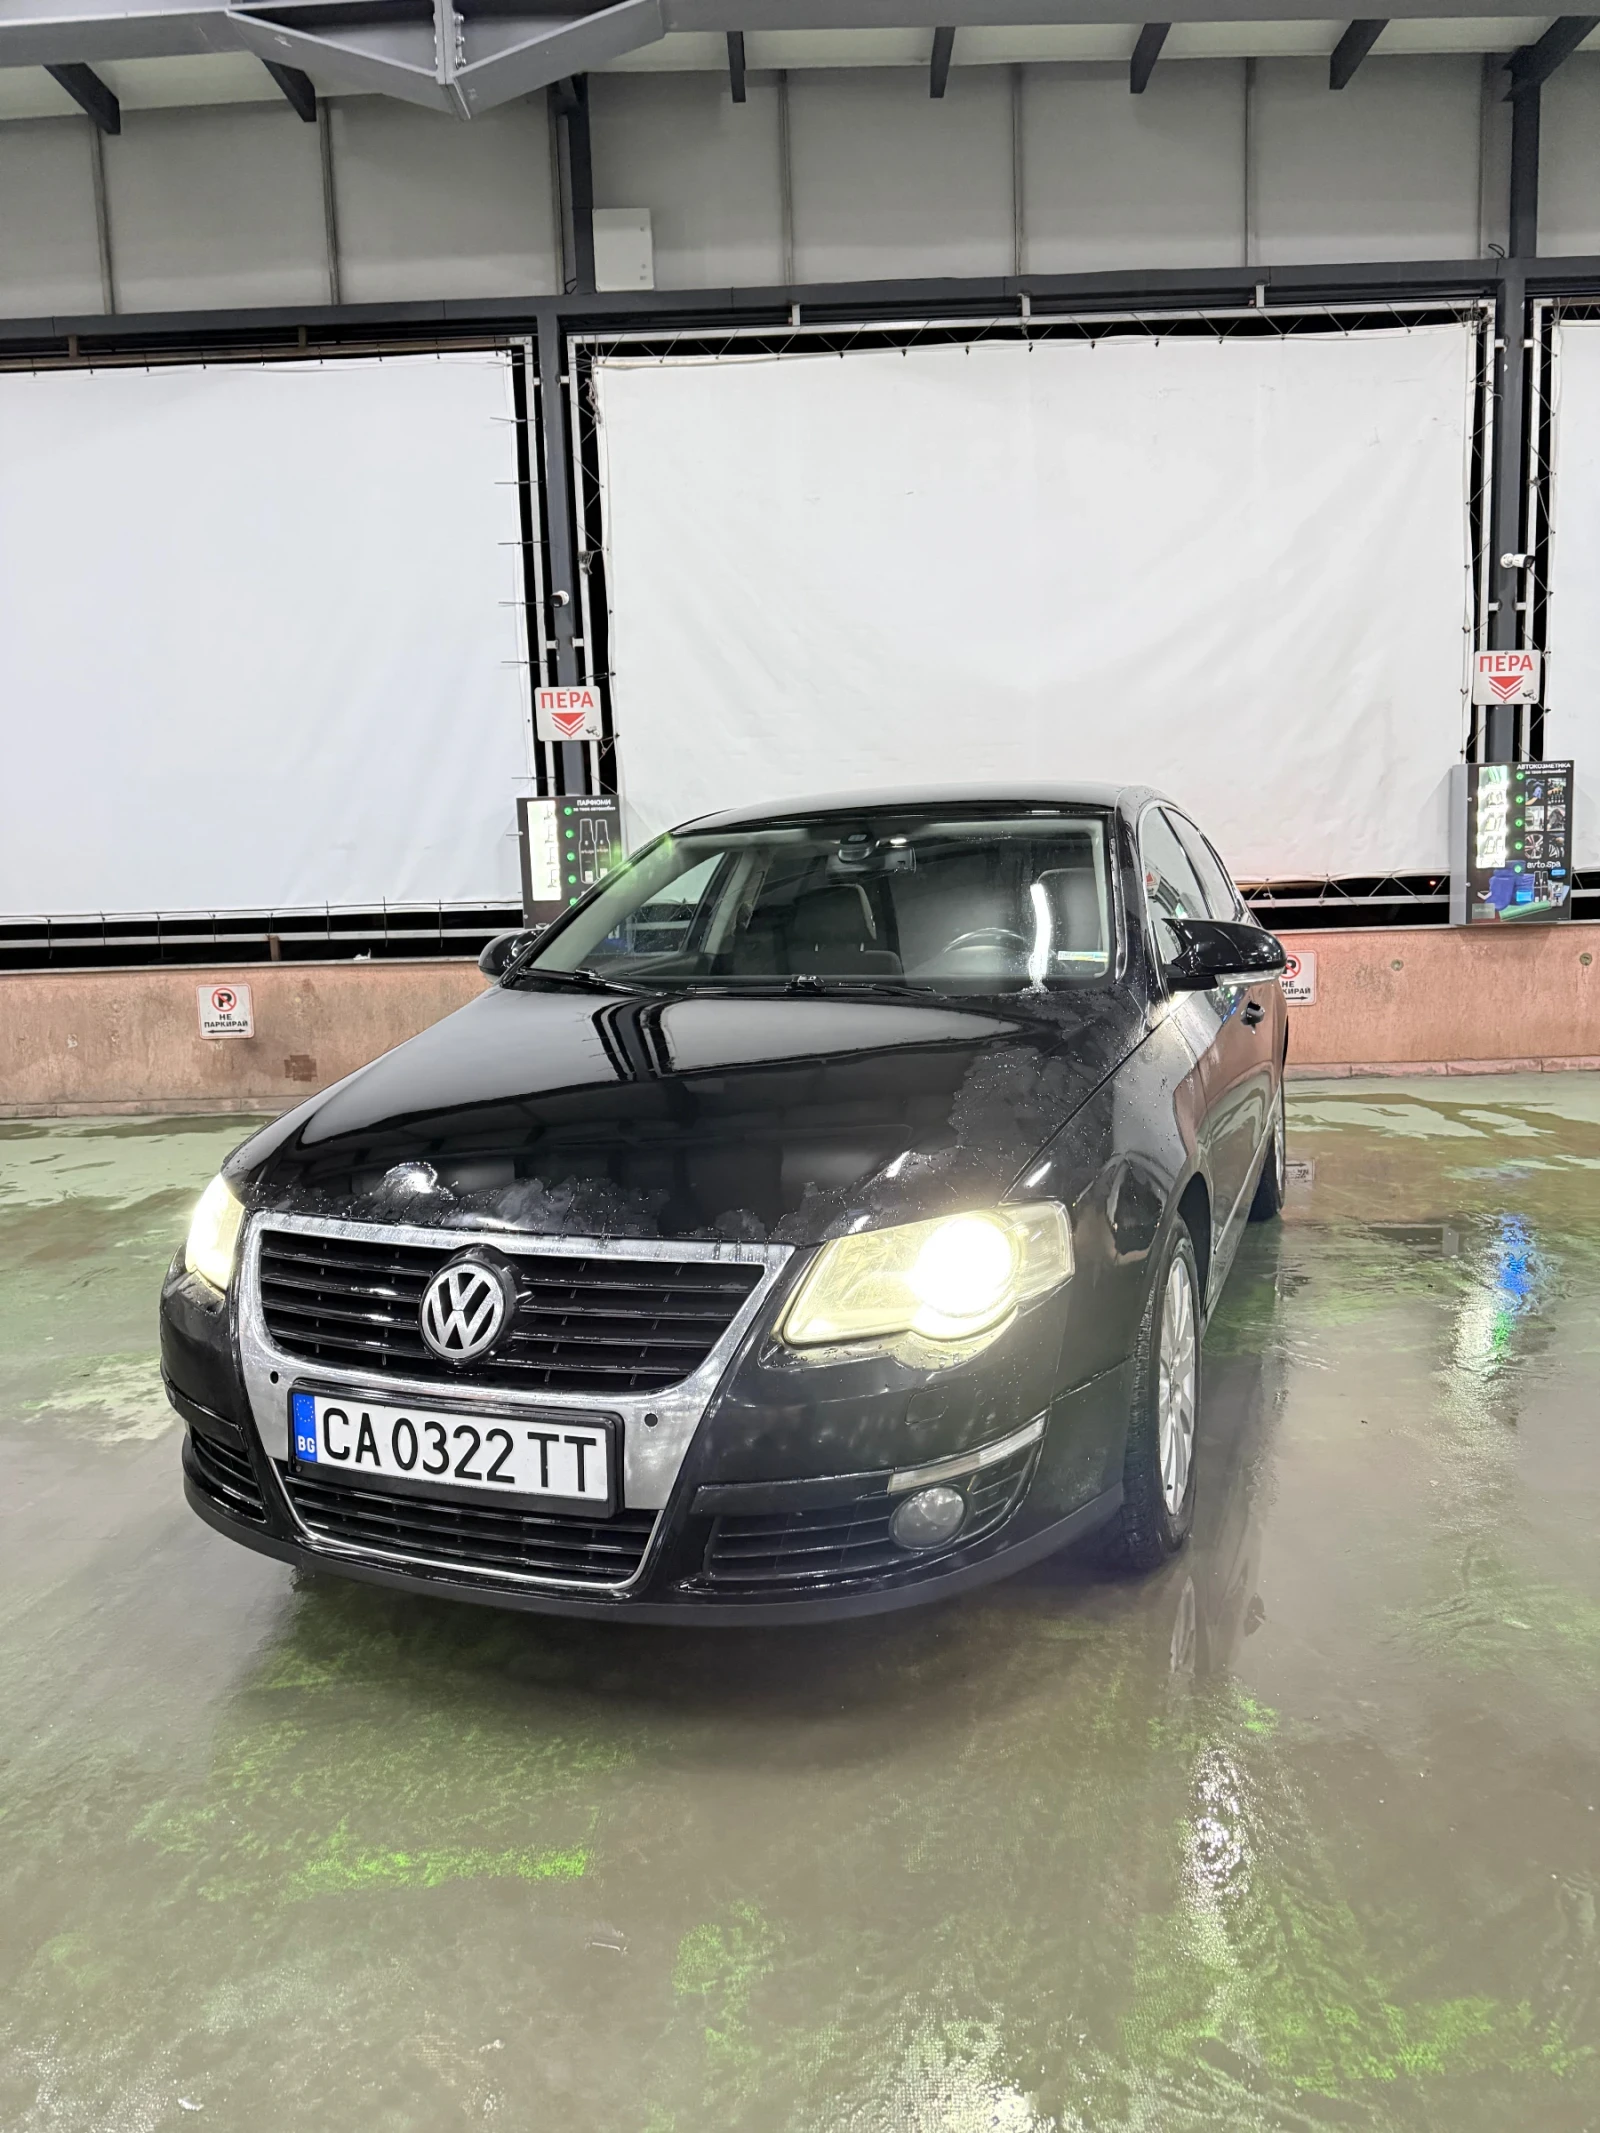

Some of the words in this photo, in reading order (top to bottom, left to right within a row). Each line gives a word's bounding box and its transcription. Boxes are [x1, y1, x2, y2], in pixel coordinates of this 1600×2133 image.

[1479, 654, 1534, 672] ПЕРА
[540, 691, 594, 709] ПЕРА
[1282, 987, 1311, 995] КИРАЙ
[204, 1020, 249, 1028] ПАРКИРАЙ
[219, 1013, 232, 1021] НЕ
[297, 1435, 316, 1454] BG
[323, 1407, 382, 1467] CA
[391, 1417, 516, 1485] 0322
[527, 1431, 597, 1493] TT
